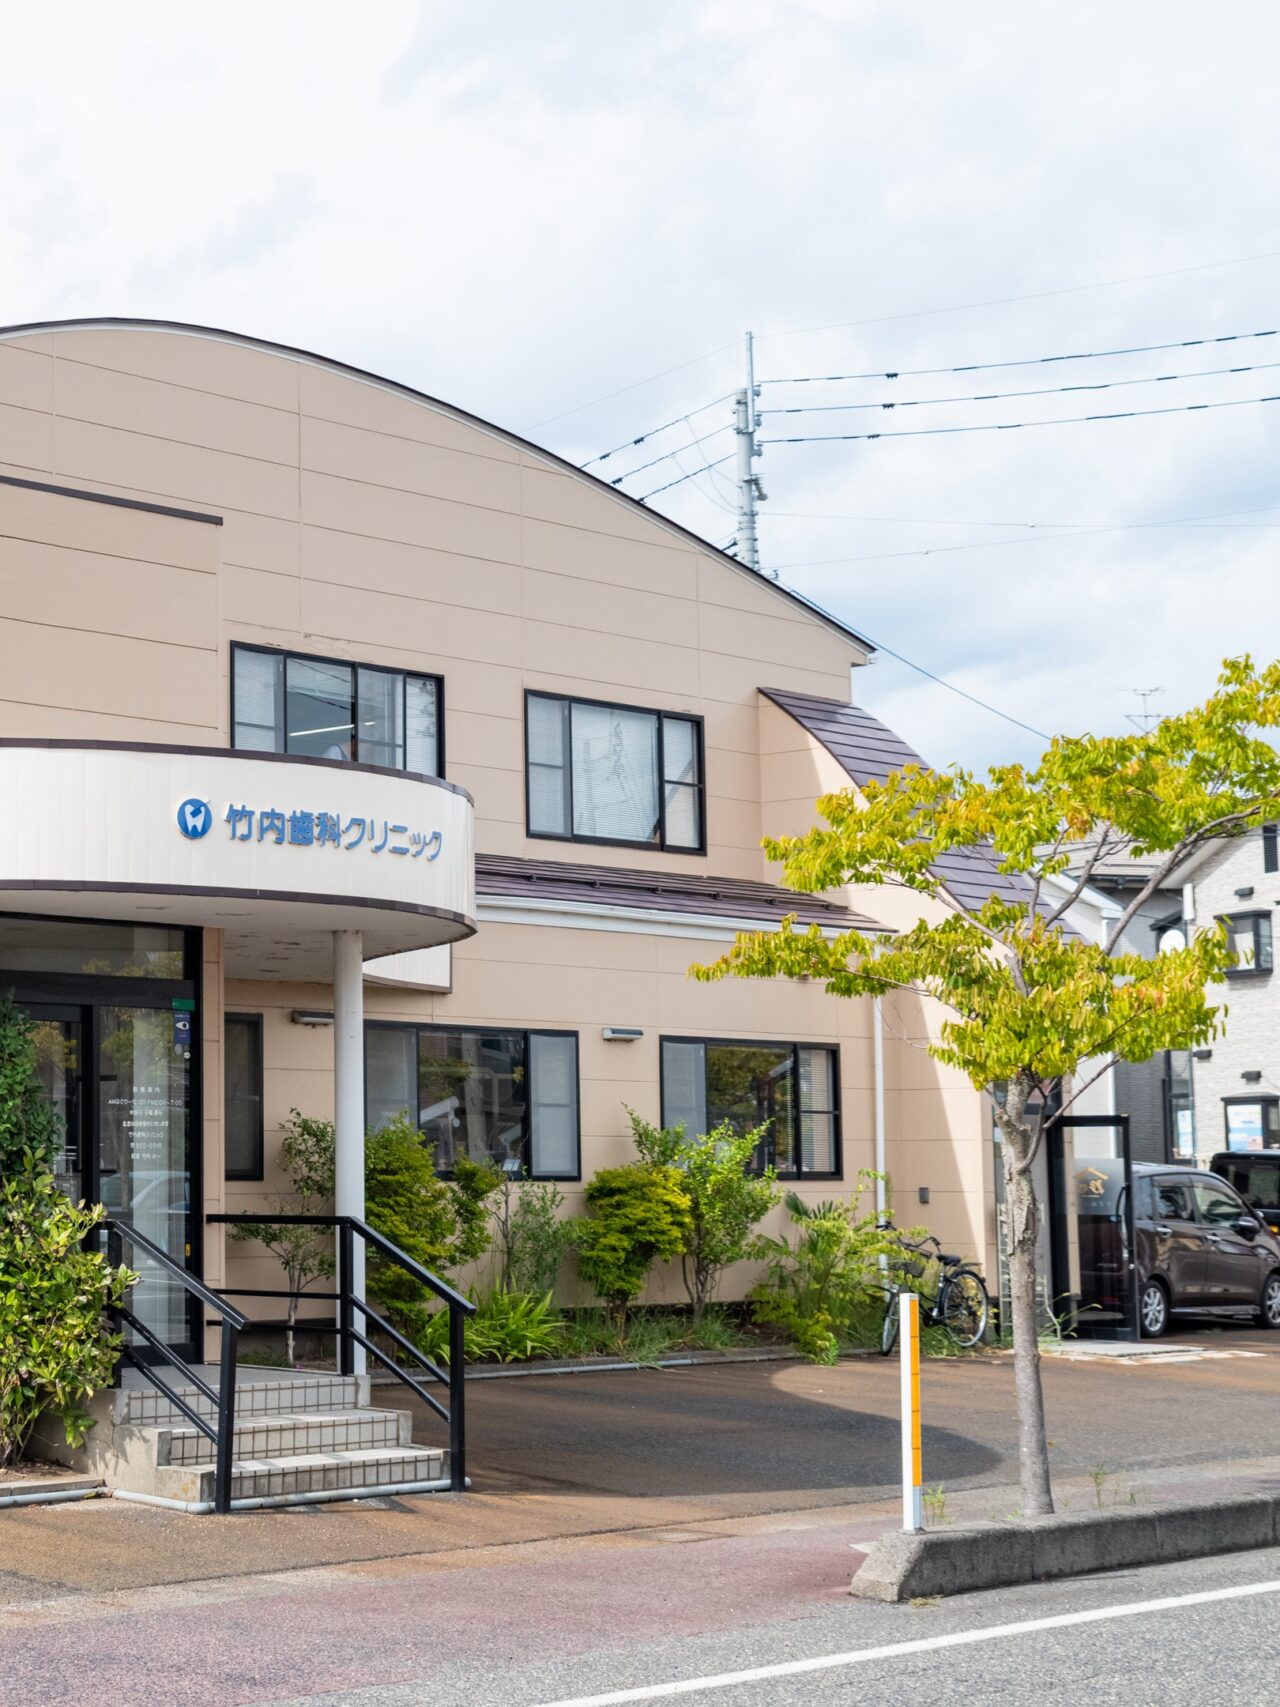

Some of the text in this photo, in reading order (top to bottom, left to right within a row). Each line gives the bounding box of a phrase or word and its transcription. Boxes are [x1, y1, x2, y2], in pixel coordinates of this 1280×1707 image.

[224, 803, 442, 861] 竹内歯科クリニック
